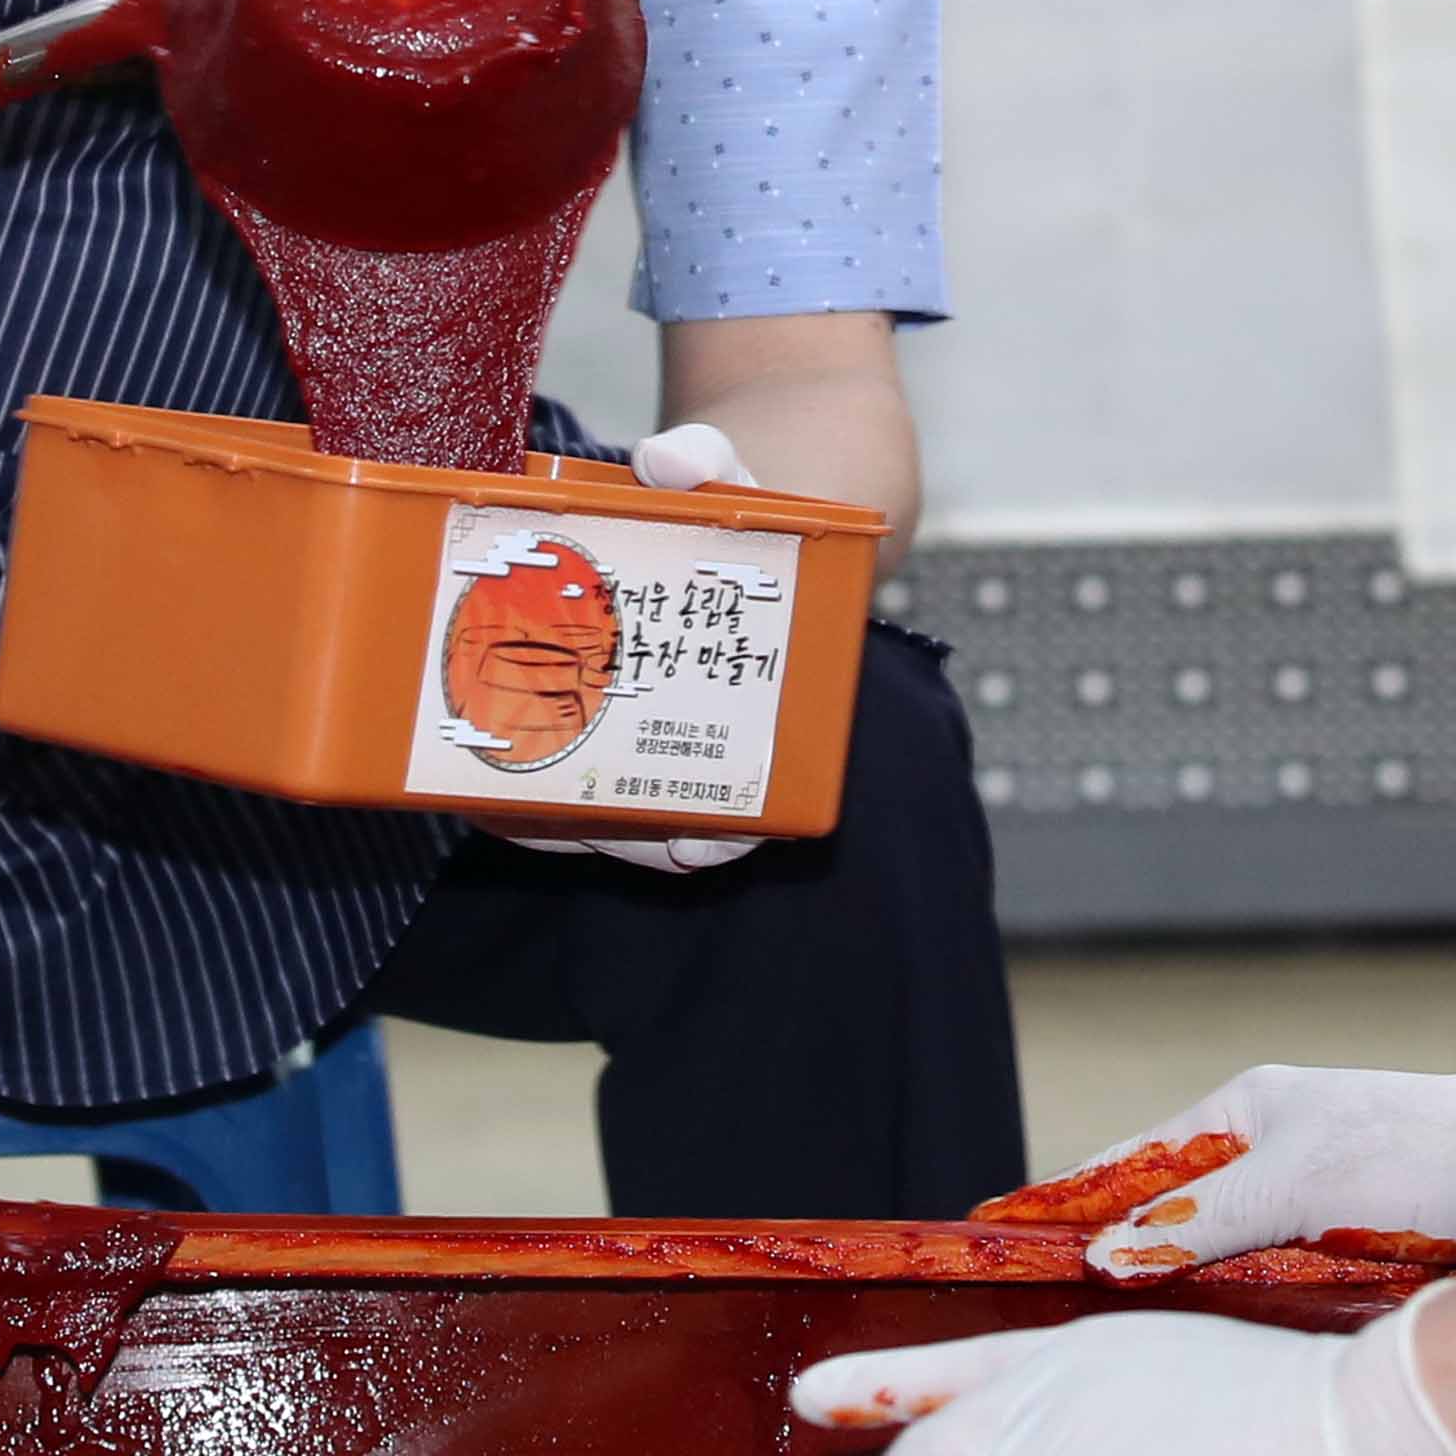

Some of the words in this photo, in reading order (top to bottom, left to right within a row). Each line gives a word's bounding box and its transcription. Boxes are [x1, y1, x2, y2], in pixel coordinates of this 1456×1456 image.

[678, 580, 745, 634] 송림골
[602, 621, 688, 681] 고추장
[697, 636, 779, 686] 만들기
[637, 719, 700, 738] 수령하시는
[705, 724, 730, 740] 즉시
[635, 737, 726, 759] 냉장보관해주세요
[615, 776, 663, 798] 송림1동
[666, 778, 733, 802] 주민자치회
